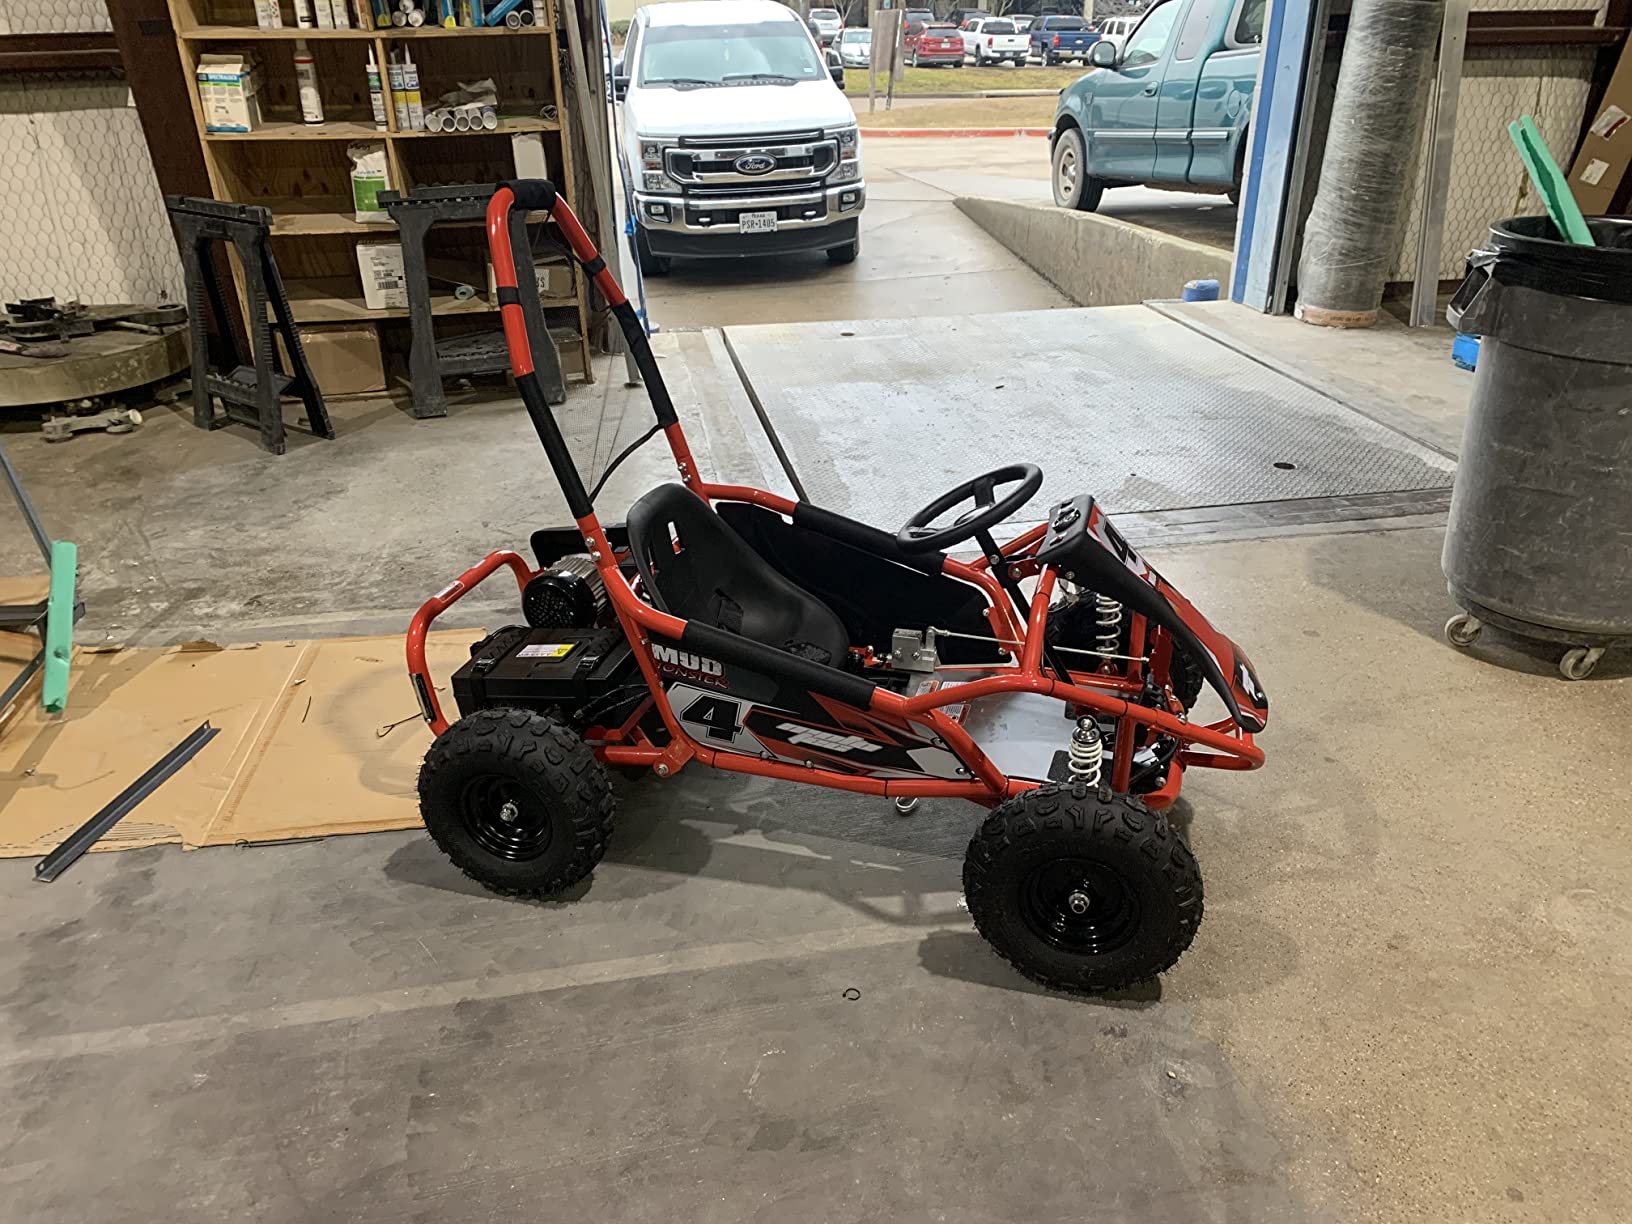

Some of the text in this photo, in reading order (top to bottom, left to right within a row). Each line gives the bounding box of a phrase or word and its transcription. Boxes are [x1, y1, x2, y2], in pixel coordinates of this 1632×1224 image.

[745, 161, 766, 170] Ford
[651, 643, 723, 677] MUD
[680, 693, 744, 743] 4
